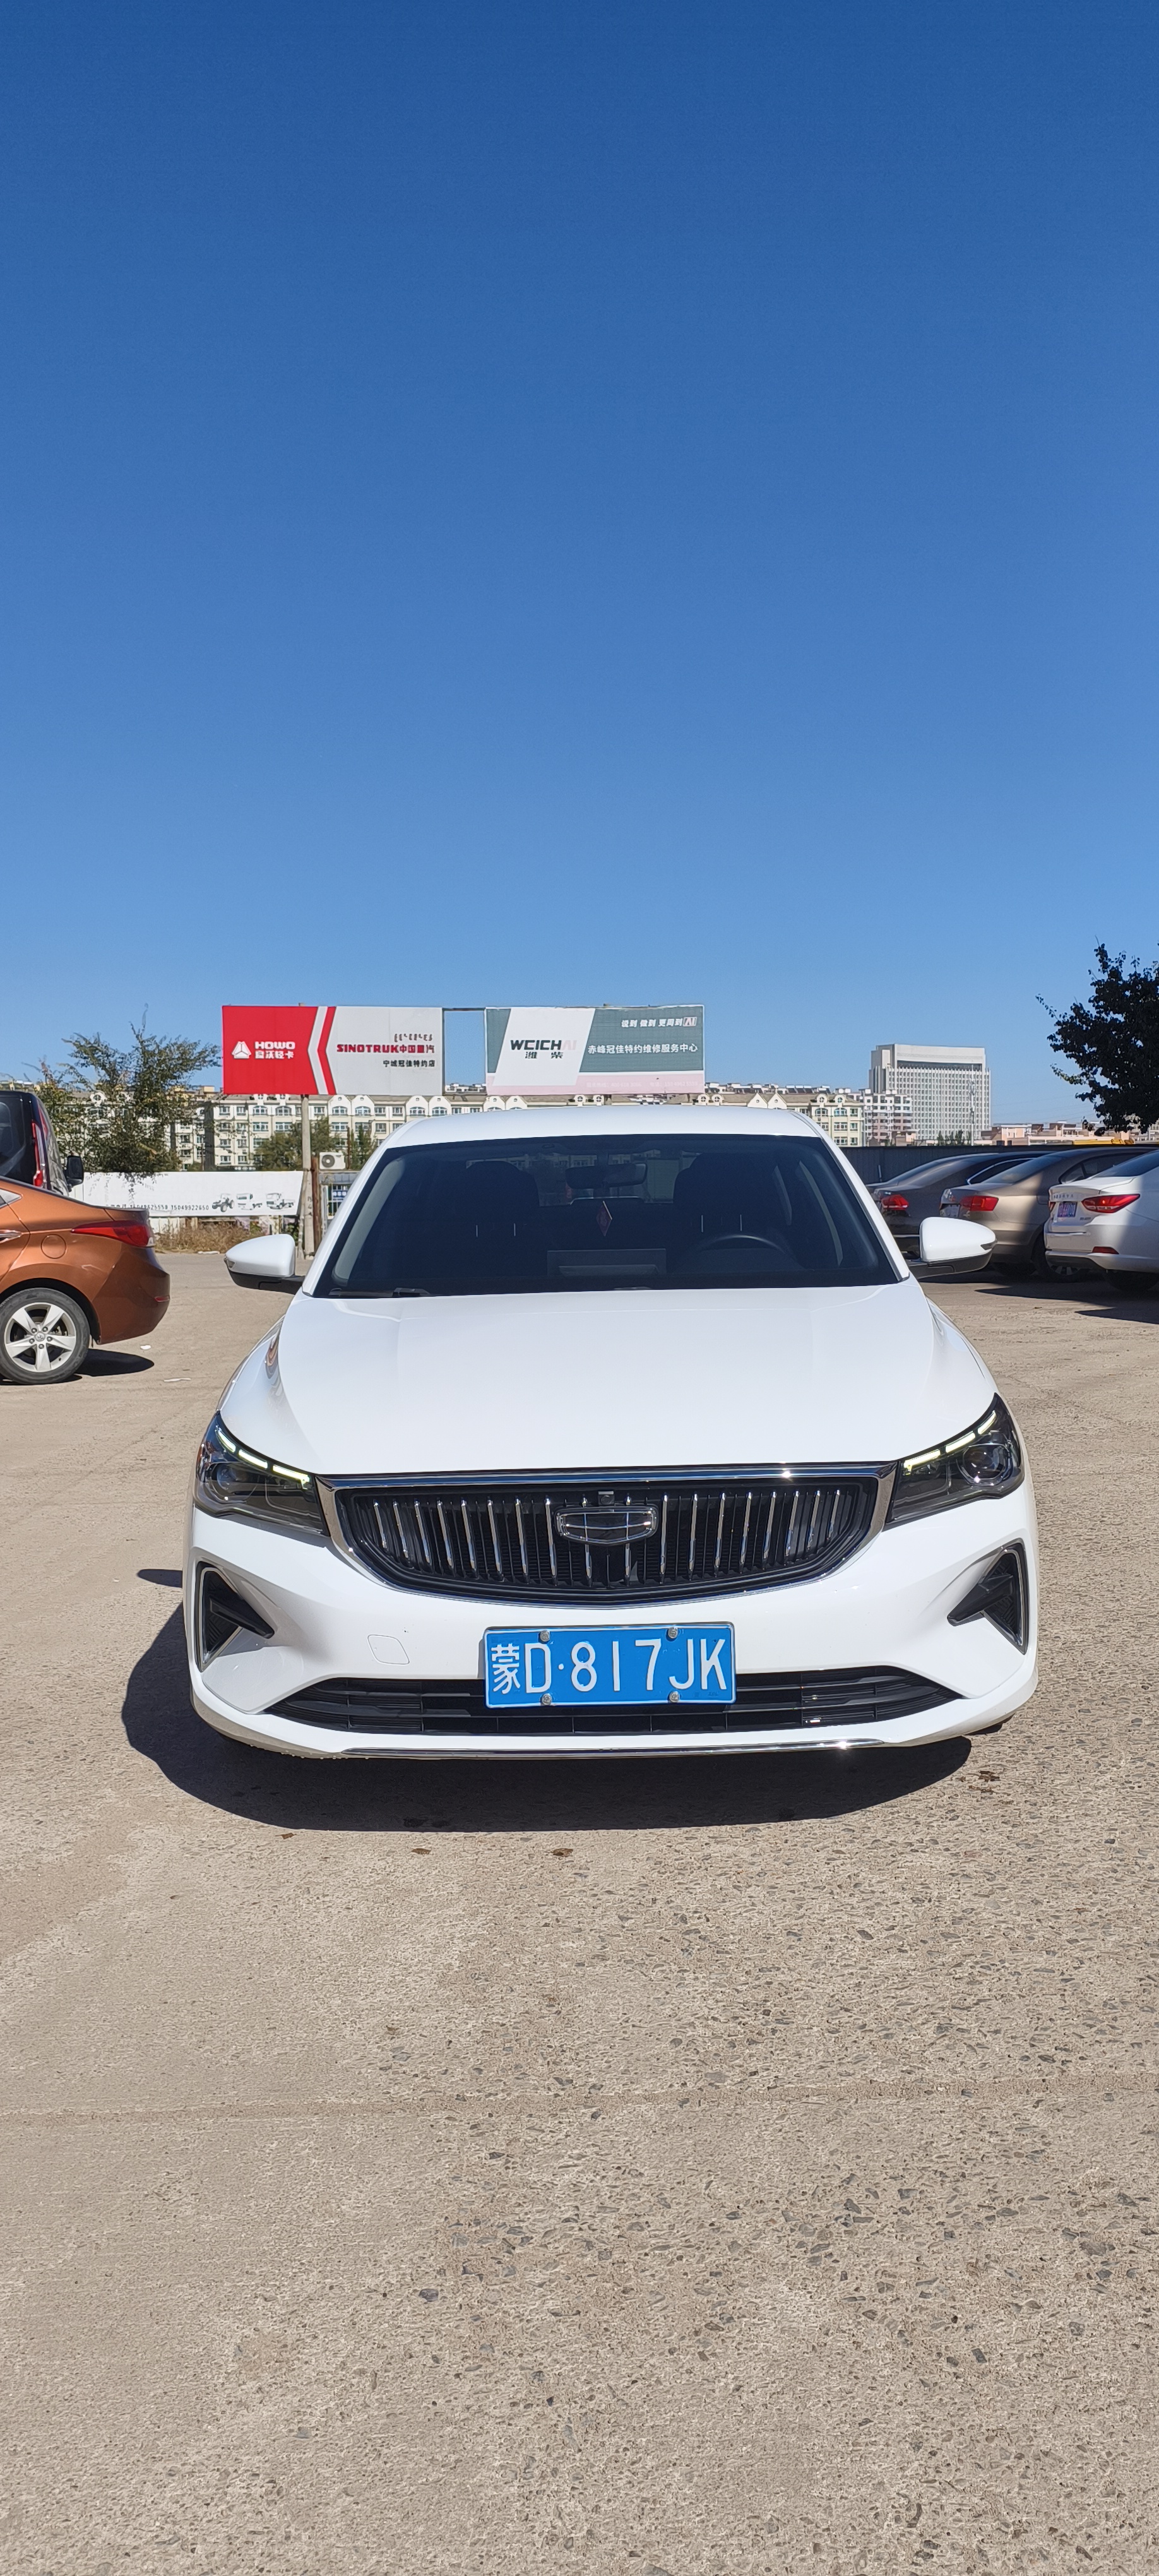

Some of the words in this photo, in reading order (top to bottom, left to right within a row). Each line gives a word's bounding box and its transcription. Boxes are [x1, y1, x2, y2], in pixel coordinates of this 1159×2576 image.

[255, 1041, 295, 1049] HOWO
[588, 1043, 698, 1054] 赤峰冠佳特约维修服务中心
[491, 1638, 727, 1695] 蒙D·817JK
